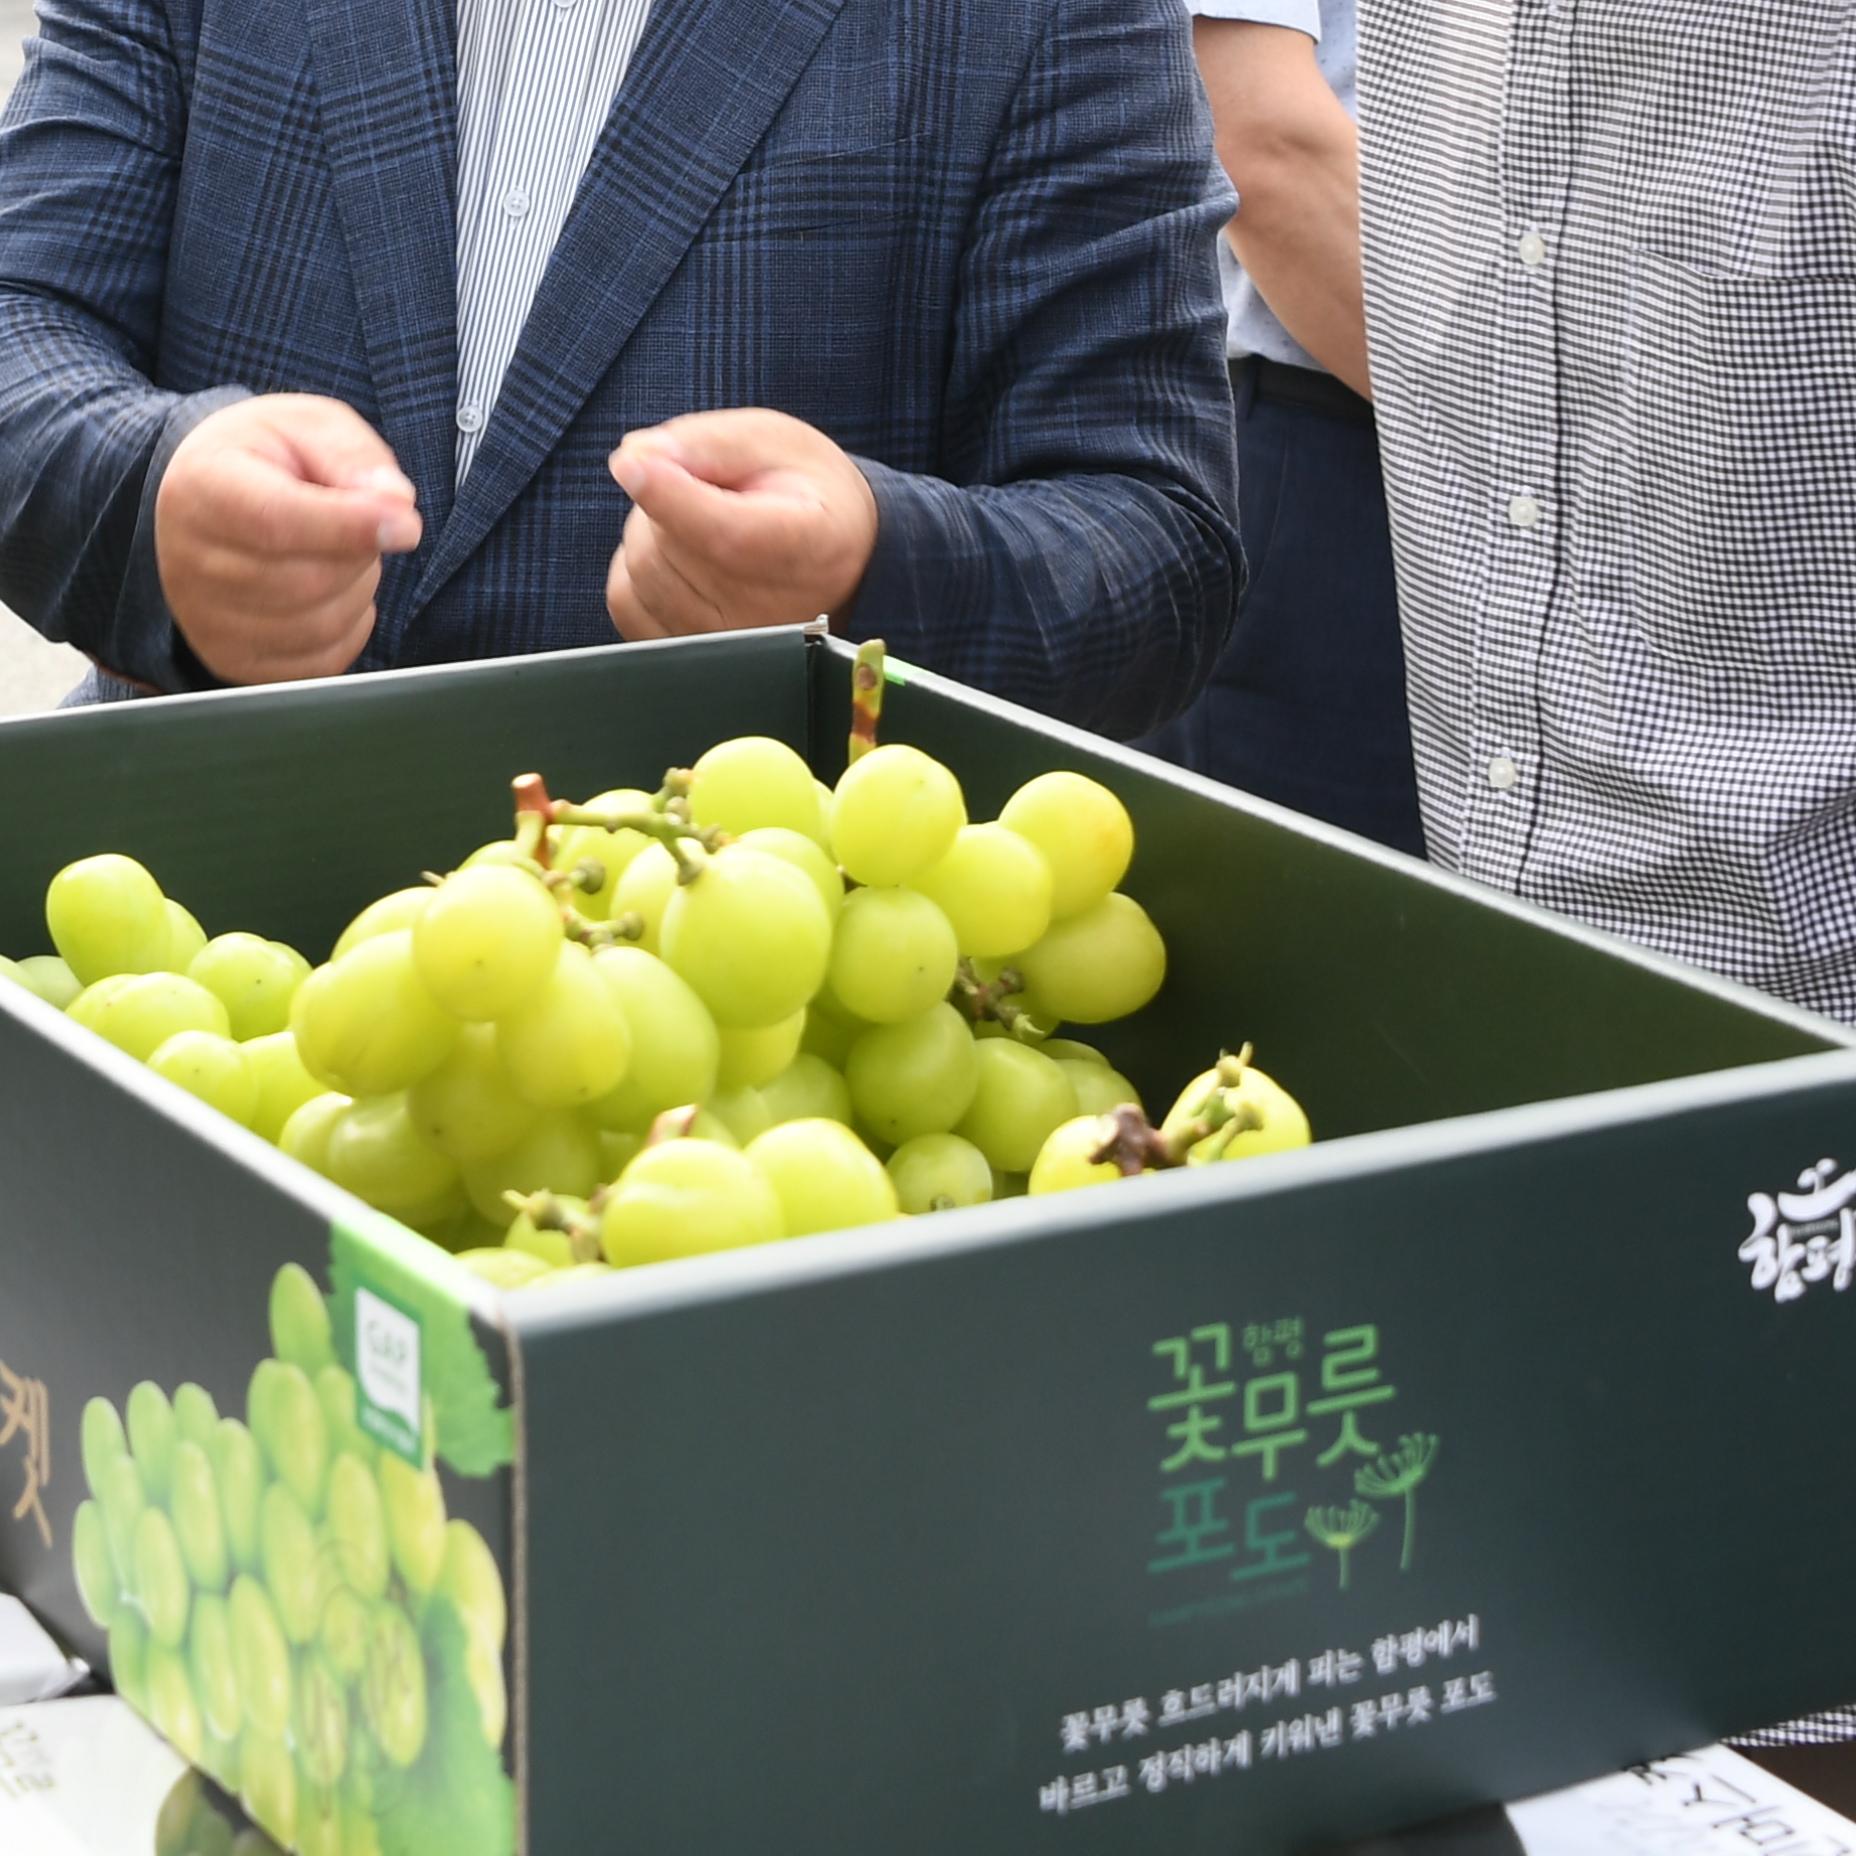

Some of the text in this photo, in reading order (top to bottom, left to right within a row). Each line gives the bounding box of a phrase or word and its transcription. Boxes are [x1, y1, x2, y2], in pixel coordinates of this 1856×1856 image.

[1147, 1321, 1396, 1482] 꽃무릇
[1243, 1317, 1303, 1367] 함평
[1147, 1477, 1312, 1581] 포도
[1039, 1670, 1497, 1815] 바르고 정직하게 키워낸 꽃무릇 포도
[1060, 1613, 1479, 1753] 꽃무릇 흐드러지게 피는 함평에서
